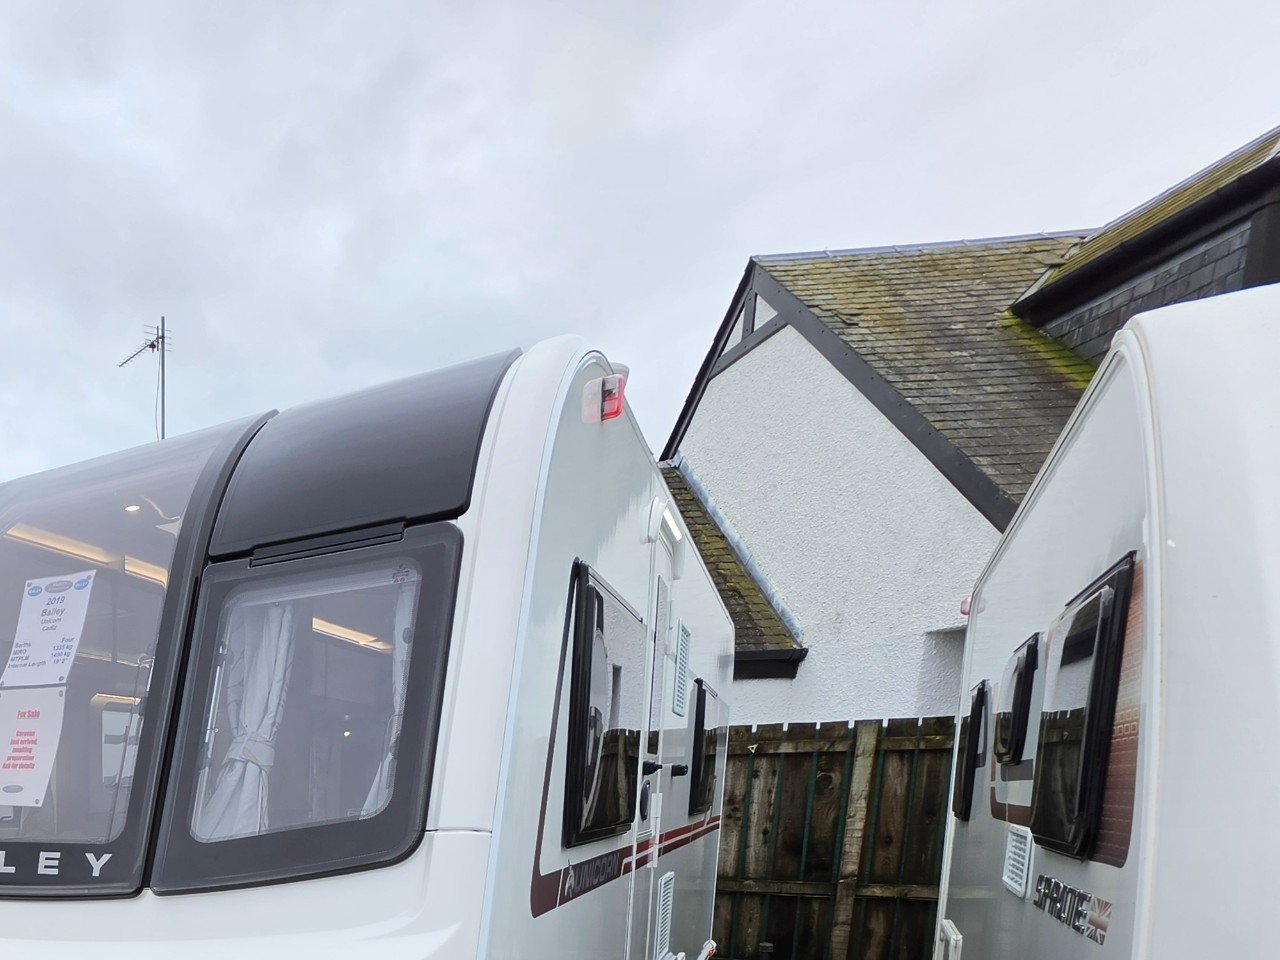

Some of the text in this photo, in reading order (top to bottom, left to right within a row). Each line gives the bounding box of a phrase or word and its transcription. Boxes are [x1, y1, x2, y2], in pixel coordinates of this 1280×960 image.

[46, 596, 66, 605] 2019
[41, 607, 66, 617] Bailey
[17, 710, 40, 718] For Sale
[574, 852, 619, 893] UNICORN
